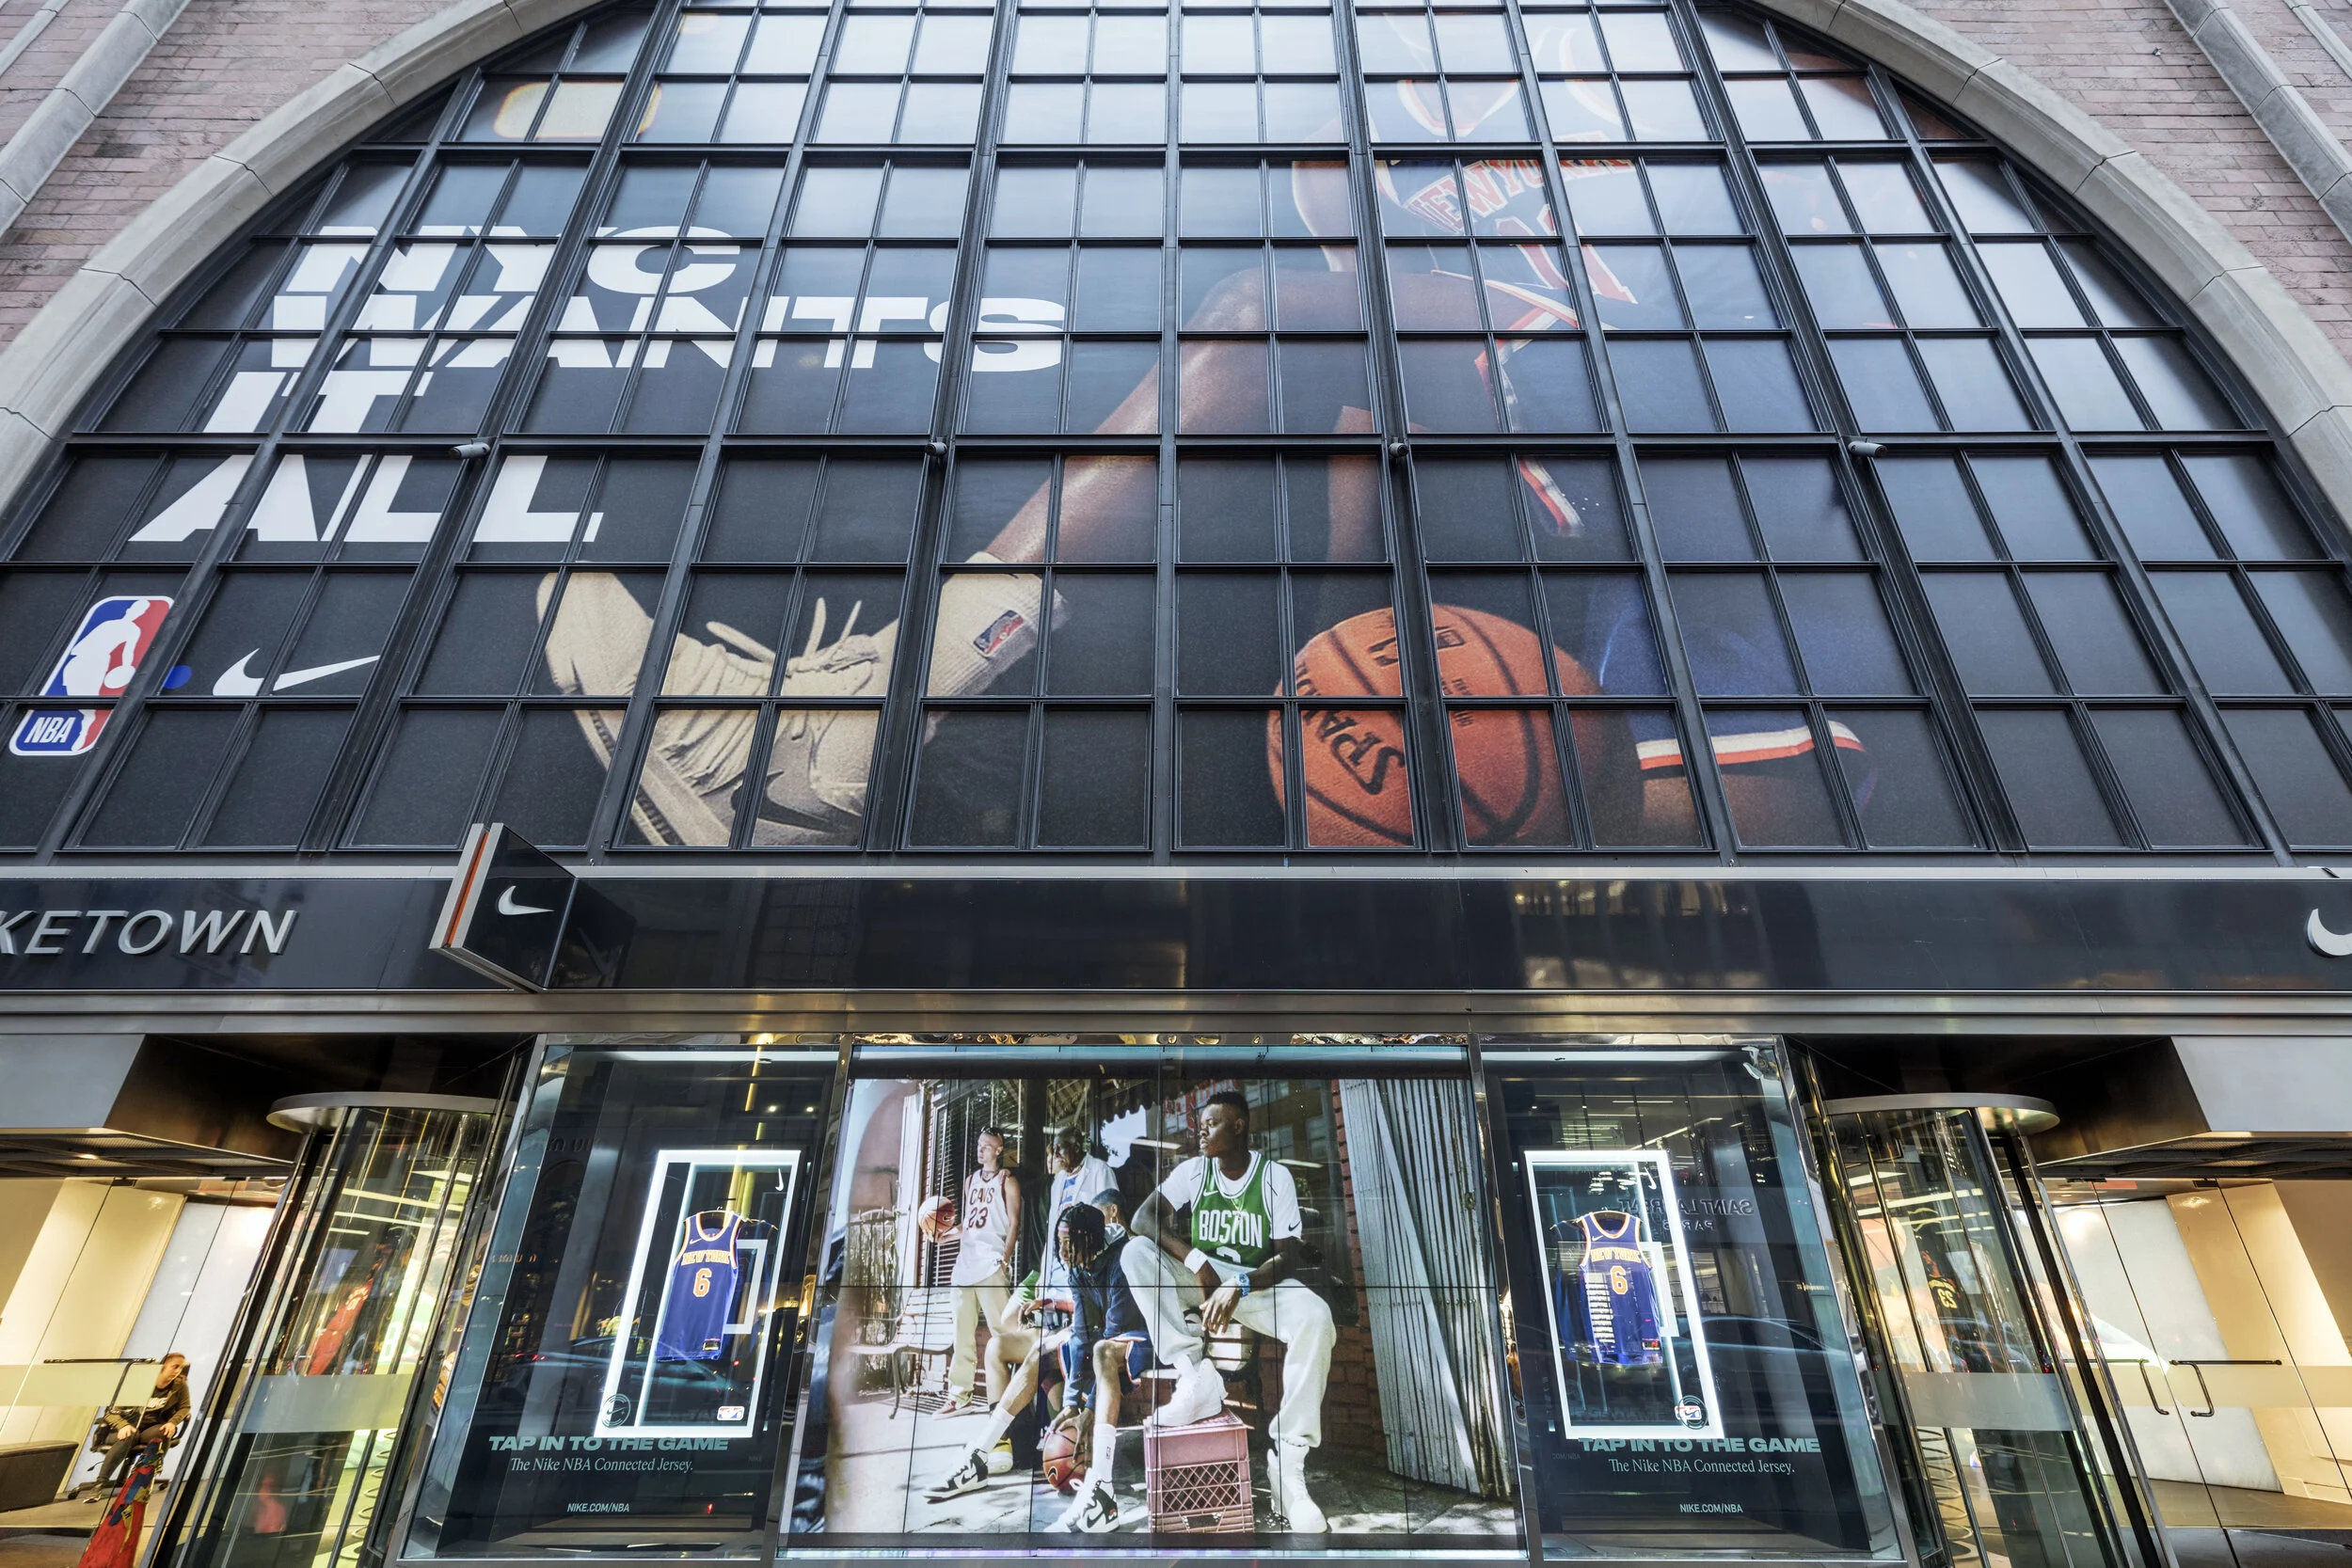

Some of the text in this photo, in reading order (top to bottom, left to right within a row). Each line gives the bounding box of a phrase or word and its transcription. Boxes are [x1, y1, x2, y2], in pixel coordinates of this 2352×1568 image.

[286, 226, 741, 294] NYC
[271, 294, 1066, 372] WANTS
[202, 371, 434, 434] IT
[24, 716, 76, 743] NBA
[968, 1207, 988, 1229] 23
[1199, 1209, 1263, 1249] BOSTON
[681, 1249, 731, 1266] NEW YORK
[1590, 1247, 1642, 1263] NEW YORK
[692, 1268, 712, 1297] 6
[1610, 1265, 1629, 1294] 6
[488, 1435, 729, 1451] TAP IN TO THE GAME
[1578, 1437, 1821, 1453] TAP IN TO THE GAME
[511, 1458, 693, 1474] The Nike NBA Connected Jersey.
[1609, 1459, 1795, 1475] The Nike NBA Connected Jersey.
[566, 1503, 630, 1513] NIKE.COM/NBA
[1679, 1503, 1743, 1513] NIKE.COM/NBA
